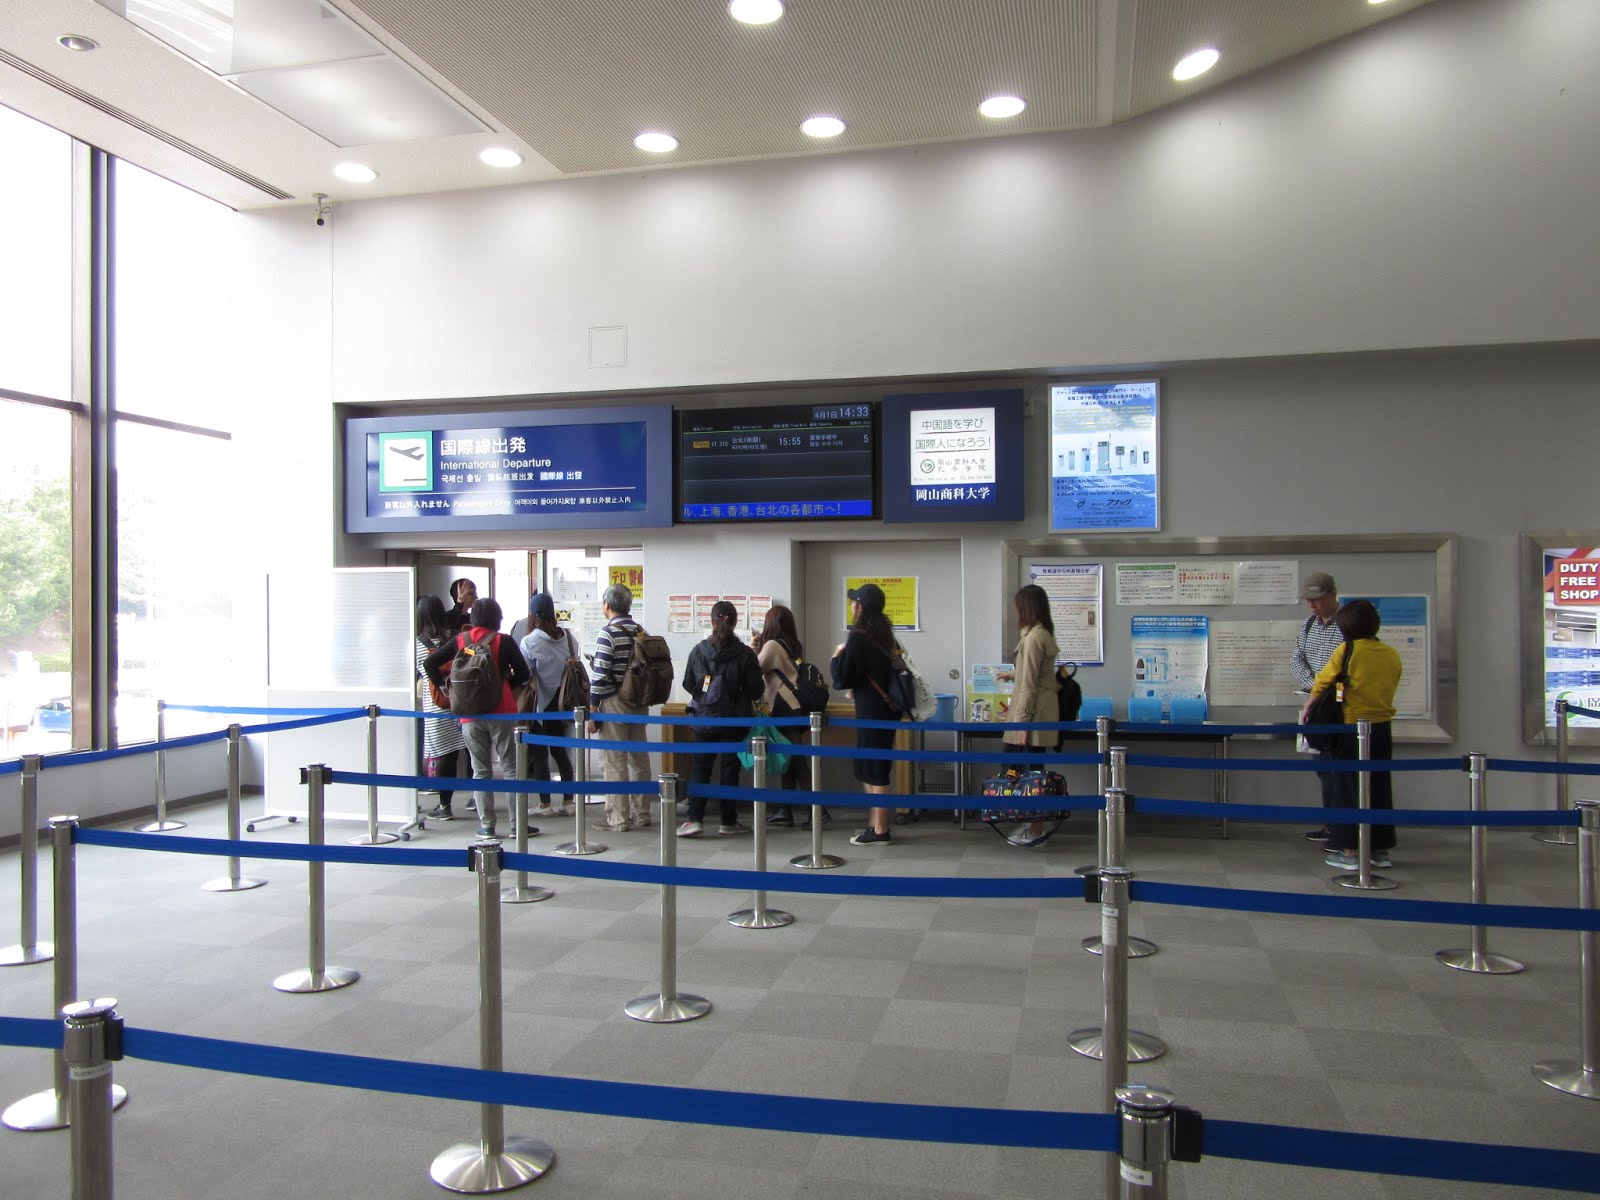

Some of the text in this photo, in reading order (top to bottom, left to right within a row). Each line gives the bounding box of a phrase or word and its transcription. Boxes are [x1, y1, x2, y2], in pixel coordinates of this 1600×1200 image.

[814, 406, 869, 419] 4月1日 14:33
[922, 417, 984, 430] 中国語を学び
[779, 437, 801, 446] 15:55
[863, 435, 869, 443] 5
[915, 436, 991, 450] 国際人になろう!
[440, 436, 527, 456] 国際線出発
[440, 458, 552, 470] International Departure
[915, 486, 991, 501] 岡山商科大学
[1560, 563, 1599, 572] DUTY
[1560, 577, 1596, 585] FREE
[1560, 589, 1600, 600] SHOP
